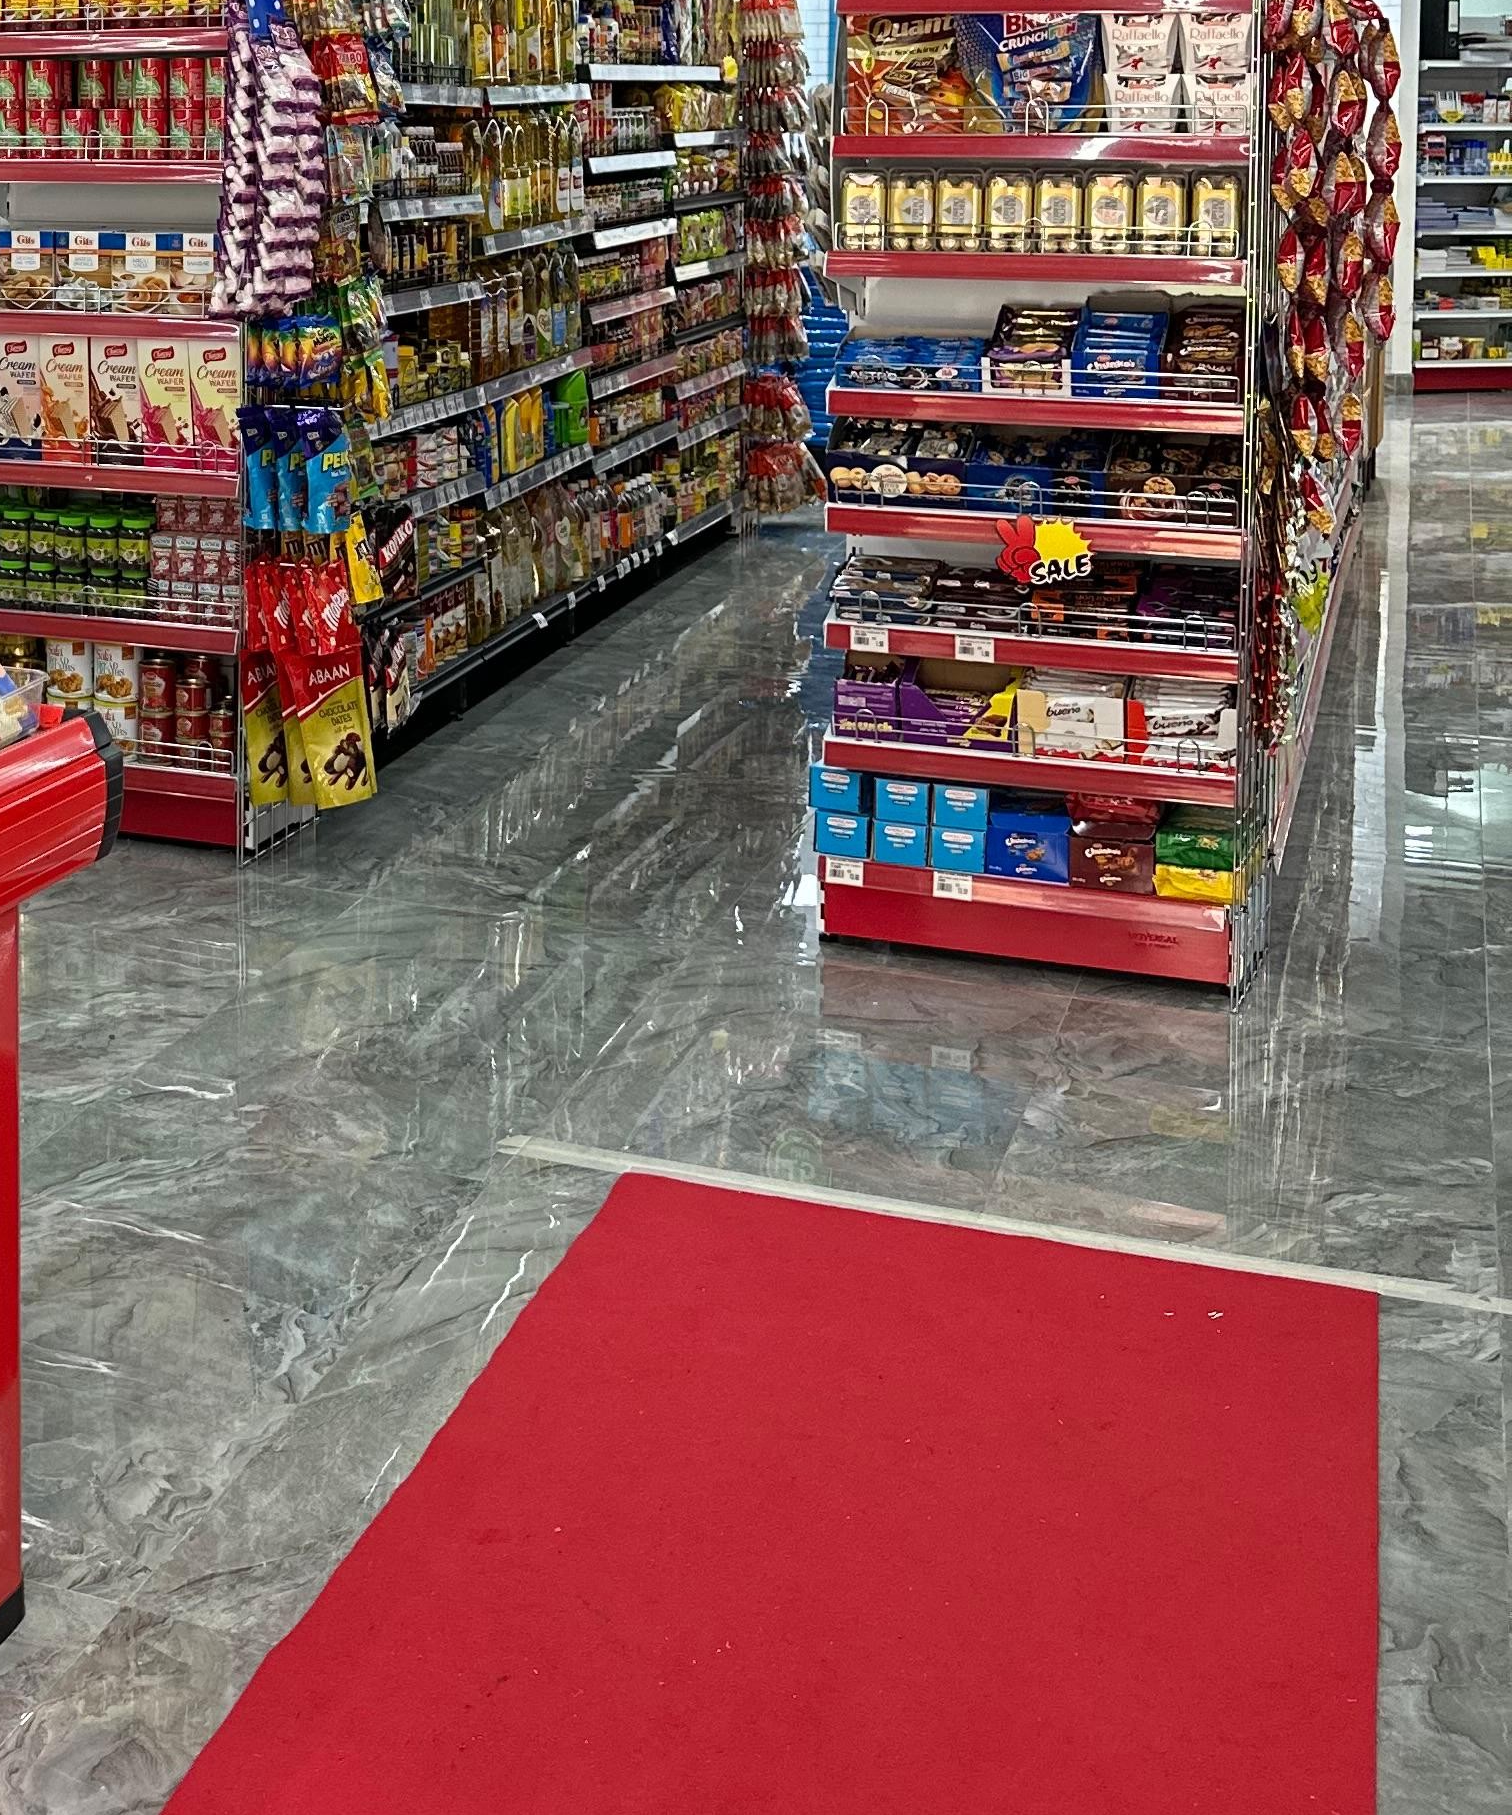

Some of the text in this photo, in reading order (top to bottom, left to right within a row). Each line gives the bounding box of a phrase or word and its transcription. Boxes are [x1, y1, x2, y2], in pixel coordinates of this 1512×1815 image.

[1112, 28, 1166, 41] Raffaello
[1190, 28, 1245, 40] Raffaello
[999, 33, 1049, 52] CRUNCH
[1115, 90, 1169, 102] Raffaello
[45, 359, 84, 373] Cream
[97, 360, 137, 375] Cream
[144, 364, 185, 378] Cream
[10, 371, 36, 379] WAFER
[57, 372, 83, 381] WAFER
[109, 374, 136, 382] WAFER
[196, 366, 237, 380] Cream
[156, 376, 185, 385] WAFER
[209, 378, 237, 387] WAFER
[1030, 554, 1092, 584] SALE
[309, 664, 350, 686] ABAAN
[1046, 706, 1081, 717] bueno
[331, 714, 352, 727] DATES
[1153, 719, 1193, 729] bueno
